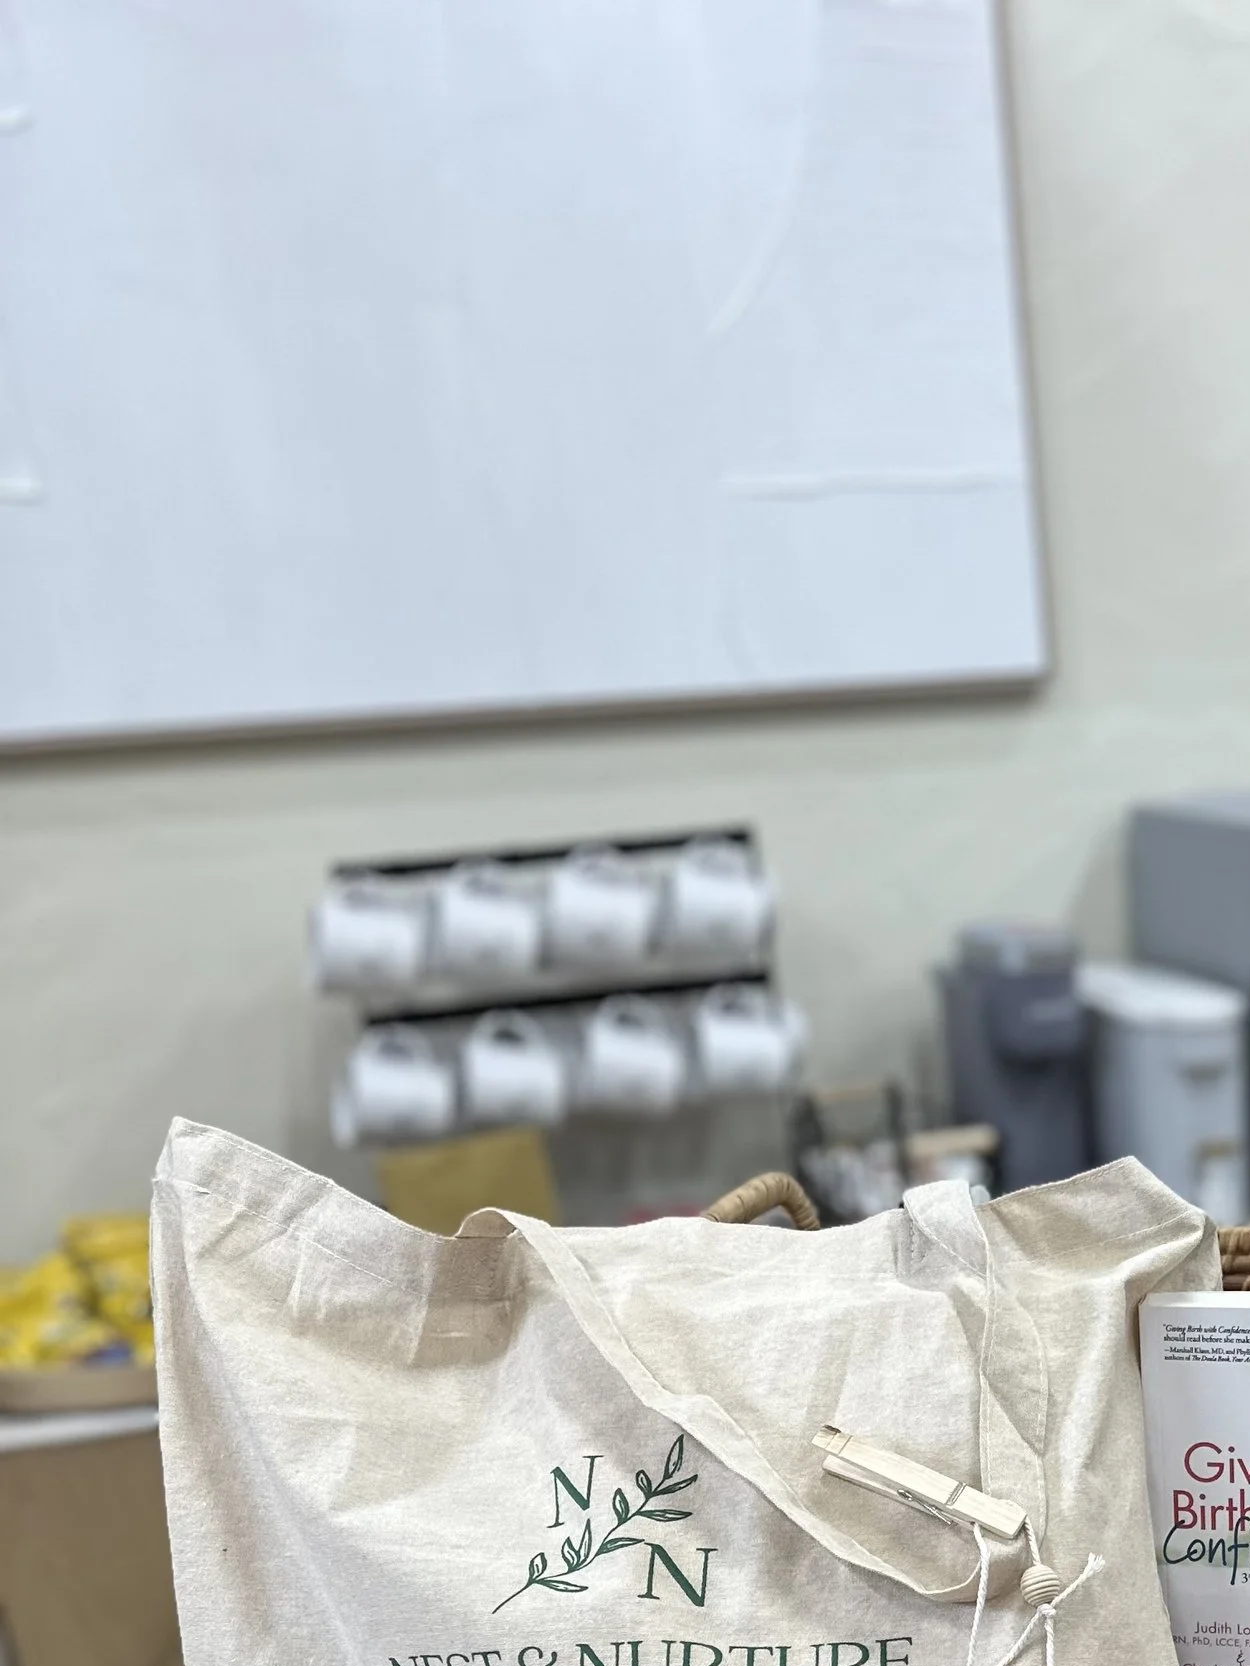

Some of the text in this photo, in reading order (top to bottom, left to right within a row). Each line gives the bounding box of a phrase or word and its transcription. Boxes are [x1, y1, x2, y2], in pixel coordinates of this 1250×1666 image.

[1163, 1334, 1185, 1342] should
[1202, 1335, 1222, 1343] before
[546, 1455, 603, 1528] N
[637, 1542, 718, 1607] N
[1194, 1621, 1232, 1635] Judith
[1192, 1637, 1212, 1647] PhD,
[1236, 1650, 1245, 1666] &
